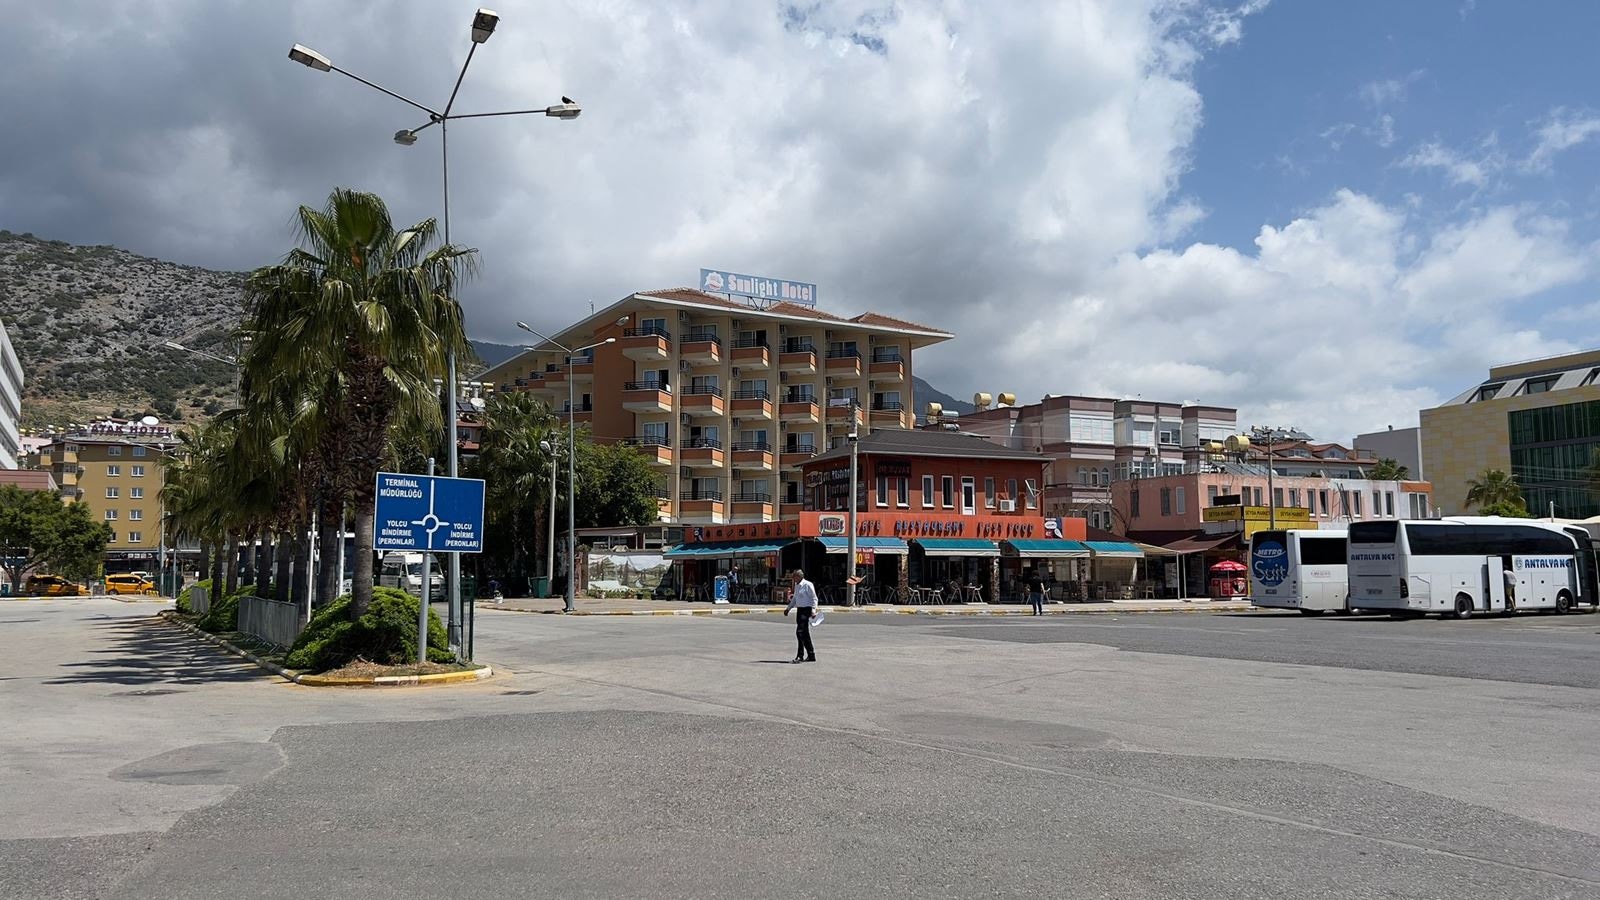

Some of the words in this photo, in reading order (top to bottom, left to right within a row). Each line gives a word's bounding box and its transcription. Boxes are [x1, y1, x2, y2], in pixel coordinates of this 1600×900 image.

[728, 275, 778, 297] Sunlight
[781, 281, 813, 301] Hotel
[91, 424, 123, 434] ATAK
[129, 425, 171, 435] HOTEL
[385, 478, 418, 487] TERMİNAL
[380, 488, 422, 498] MÜDÜRLÜĞÜ
[387, 520, 408, 528] YOLCU
[894, 519, 966, 534] RESTAURANT
[381, 528, 412, 537] BİNDİRME
[450, 531, 475, 539] İNDİRME
[377, 537, 415, 546] (PERONLAR)
[445, 539, 479, 548] (PERONLAR)
[1351, 553, 1380, 561] ANTALYA
[1525, 559, 1559, 568] ANTALYA
[1255, 560, 1286, 581] Suit
